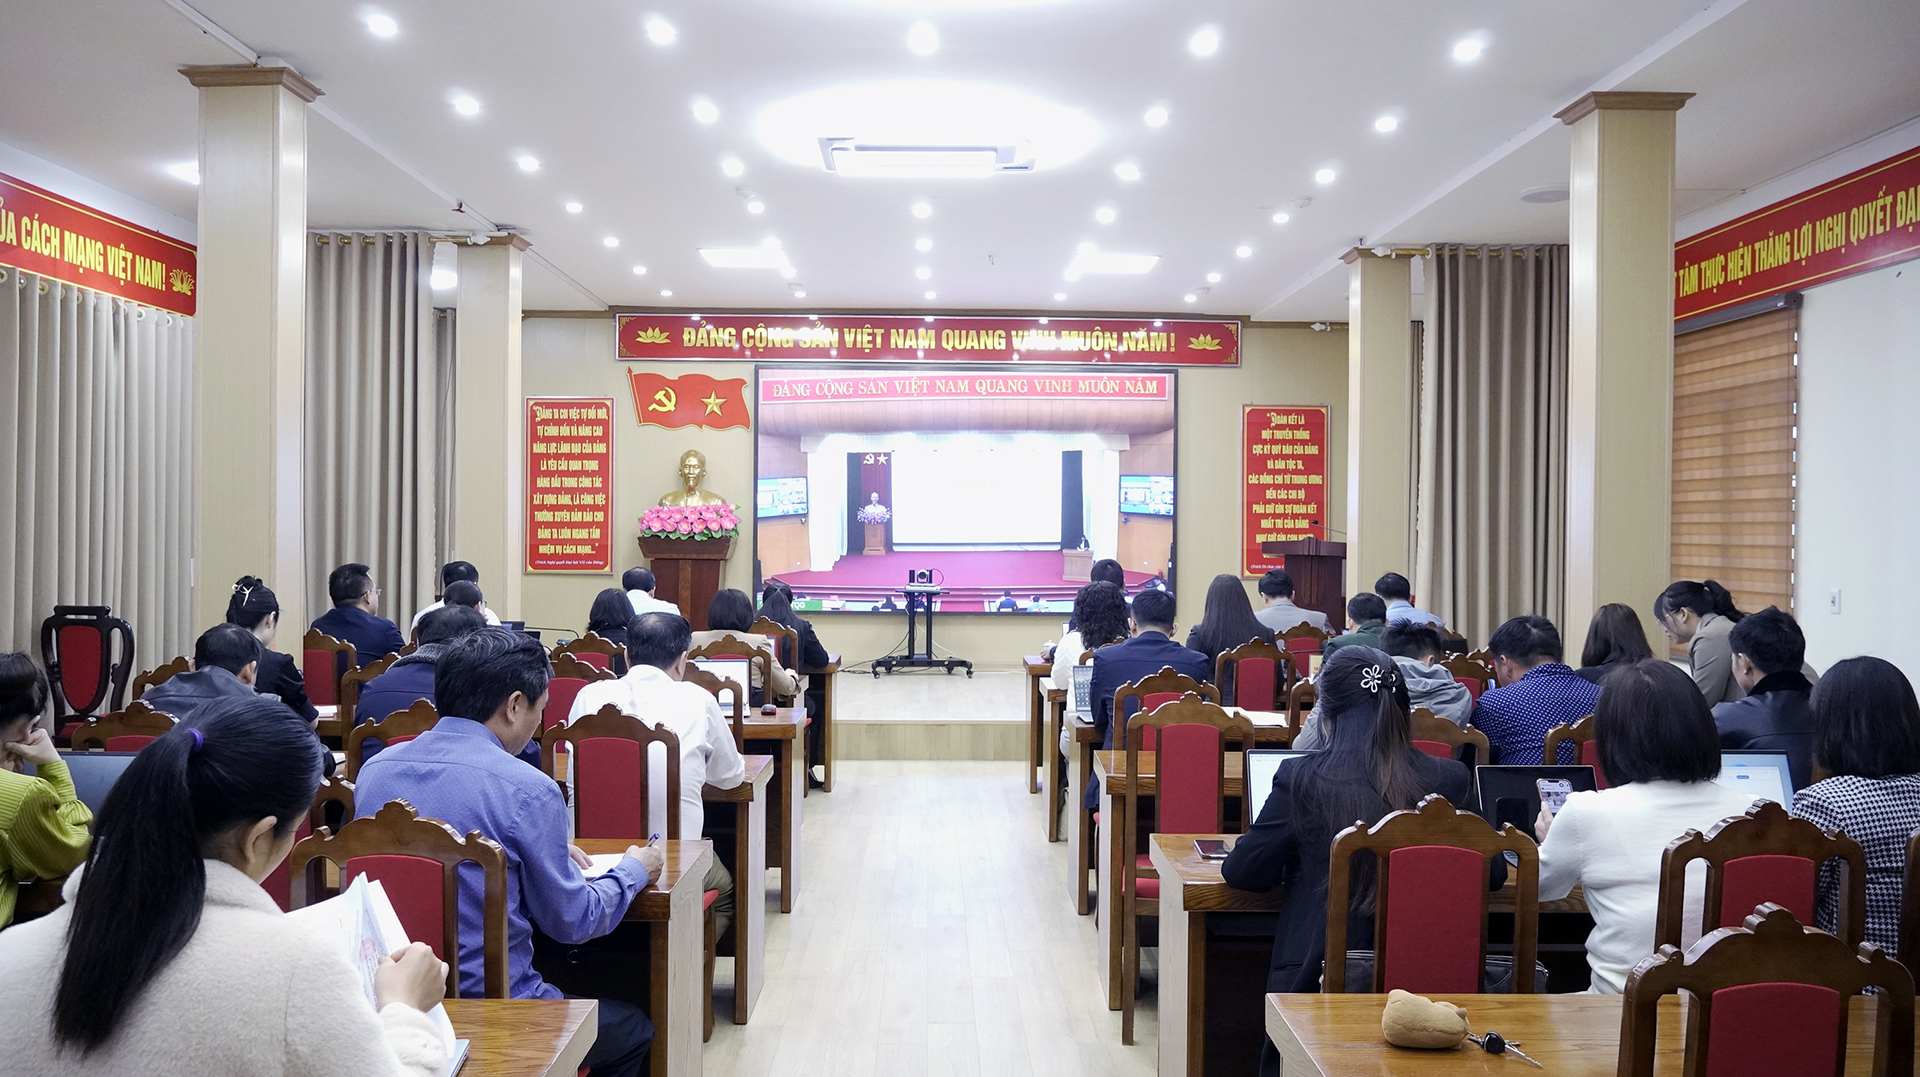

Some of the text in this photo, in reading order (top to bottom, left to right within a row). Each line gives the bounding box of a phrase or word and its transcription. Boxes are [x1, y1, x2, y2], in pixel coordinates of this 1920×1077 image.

[21, 213, 60, 260] CÁCH
[64, 230, 104, 273] MẠNG
[107, 243, 133, 286] VIỆT
[135, 255, 166, 291] NAM!
[1679, 261, 1698, 297] TÂM
[1700, 253, 1725, 293] THỰC
[1727, 241, 1751, 285] HIỆN
[1793, 221, 1812, 266] LỢI
[1815, 211, 1846, 254] NGHỊ
[1850, 185, 1893, 246] QUYẾT
[682, 320, 735, 348] ĐẢNG
[742, 323, 794, 352] CỘNG
[799, 320, 839, 349] SẢN
[843, 324, 885, 353] VIỆT
[890, 328, 936, 350] NAM
[941, 328, 1006, 351] QUANG
[1061, 326, 1118, 352] MUÔN
[772, 379, 811, 398] ĐẢNG
[817, 378, 854, 399] CỘNG
[896, 375, 931, 398] VIỆT
[935, 378, 970, 394] NAM
[975, 378, 1028, 397] QUANG
[1034, 378, 1073, 394] VINH
[1078, 375, 1120, 395] MUÔN
[1125, 376, 1158, 395] NĂM
